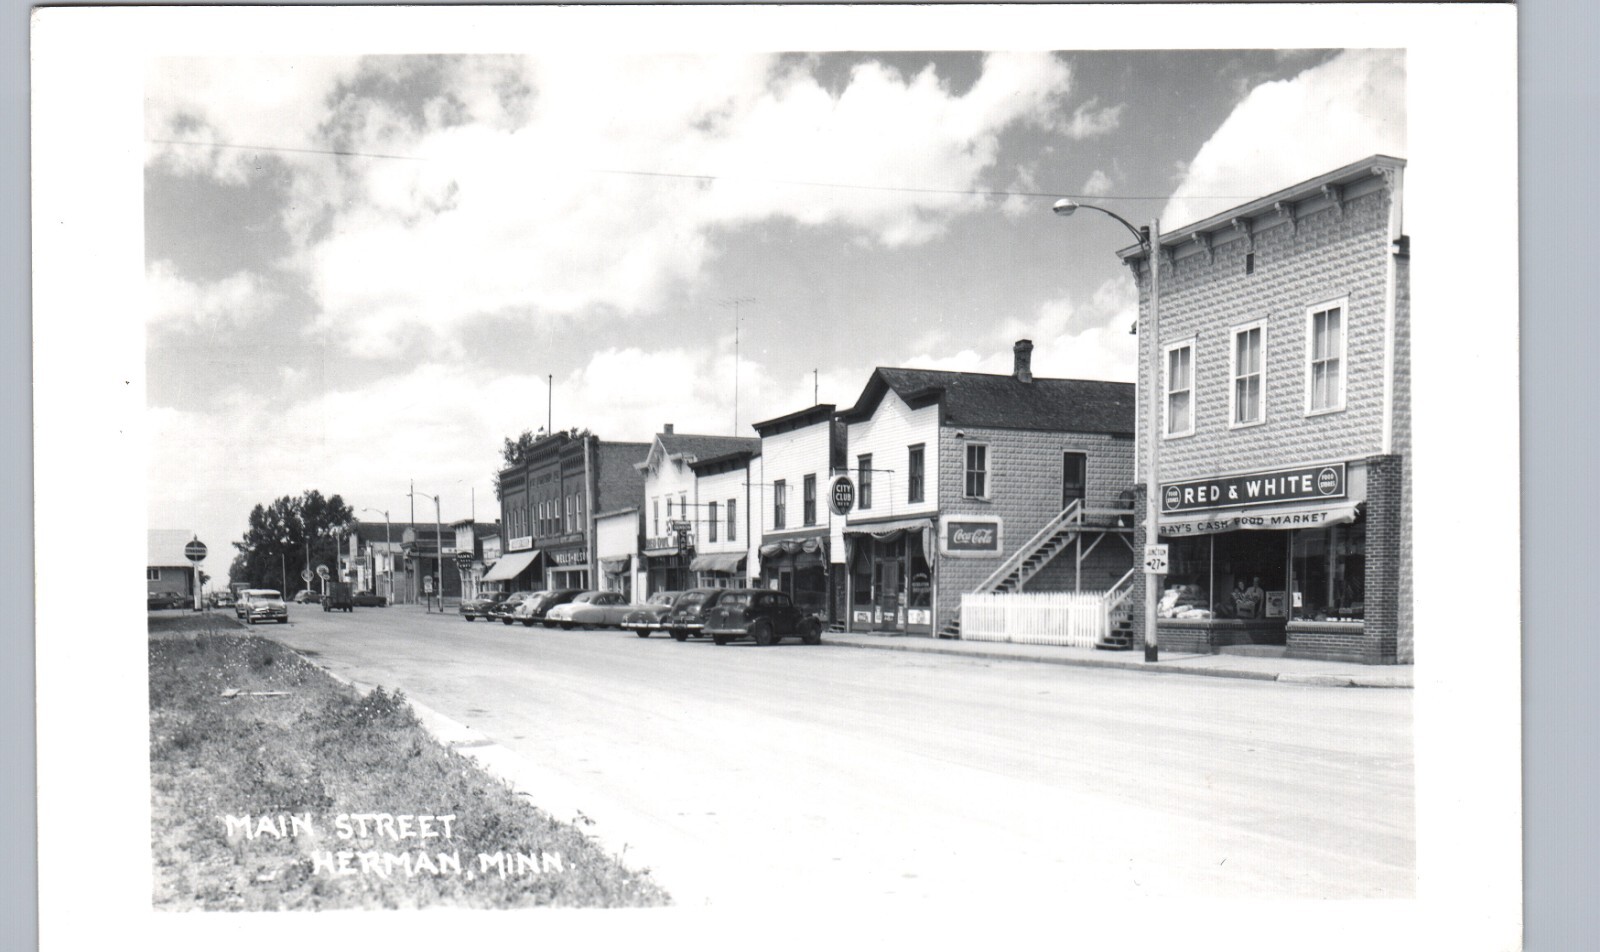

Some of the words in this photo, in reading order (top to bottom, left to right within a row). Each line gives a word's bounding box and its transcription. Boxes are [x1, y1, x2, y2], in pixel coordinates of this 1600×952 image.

[835, 484, 851, 493] CITY
[1184, 485, 1220, 504] RED
[1228, 485, 1239, 500] &
[1246, 474, 1313, 498] WHITE
[835, 492, 852, 502] CLUB
[1160, 523, 1192, 535] RAY'S
[1197, 519, 1228, 531] CASH
[1233, 516, 1264, 526] FOOD
[1270, 512, 1328, 525] MARKET
[1151, 558, 1161, 570] 27
